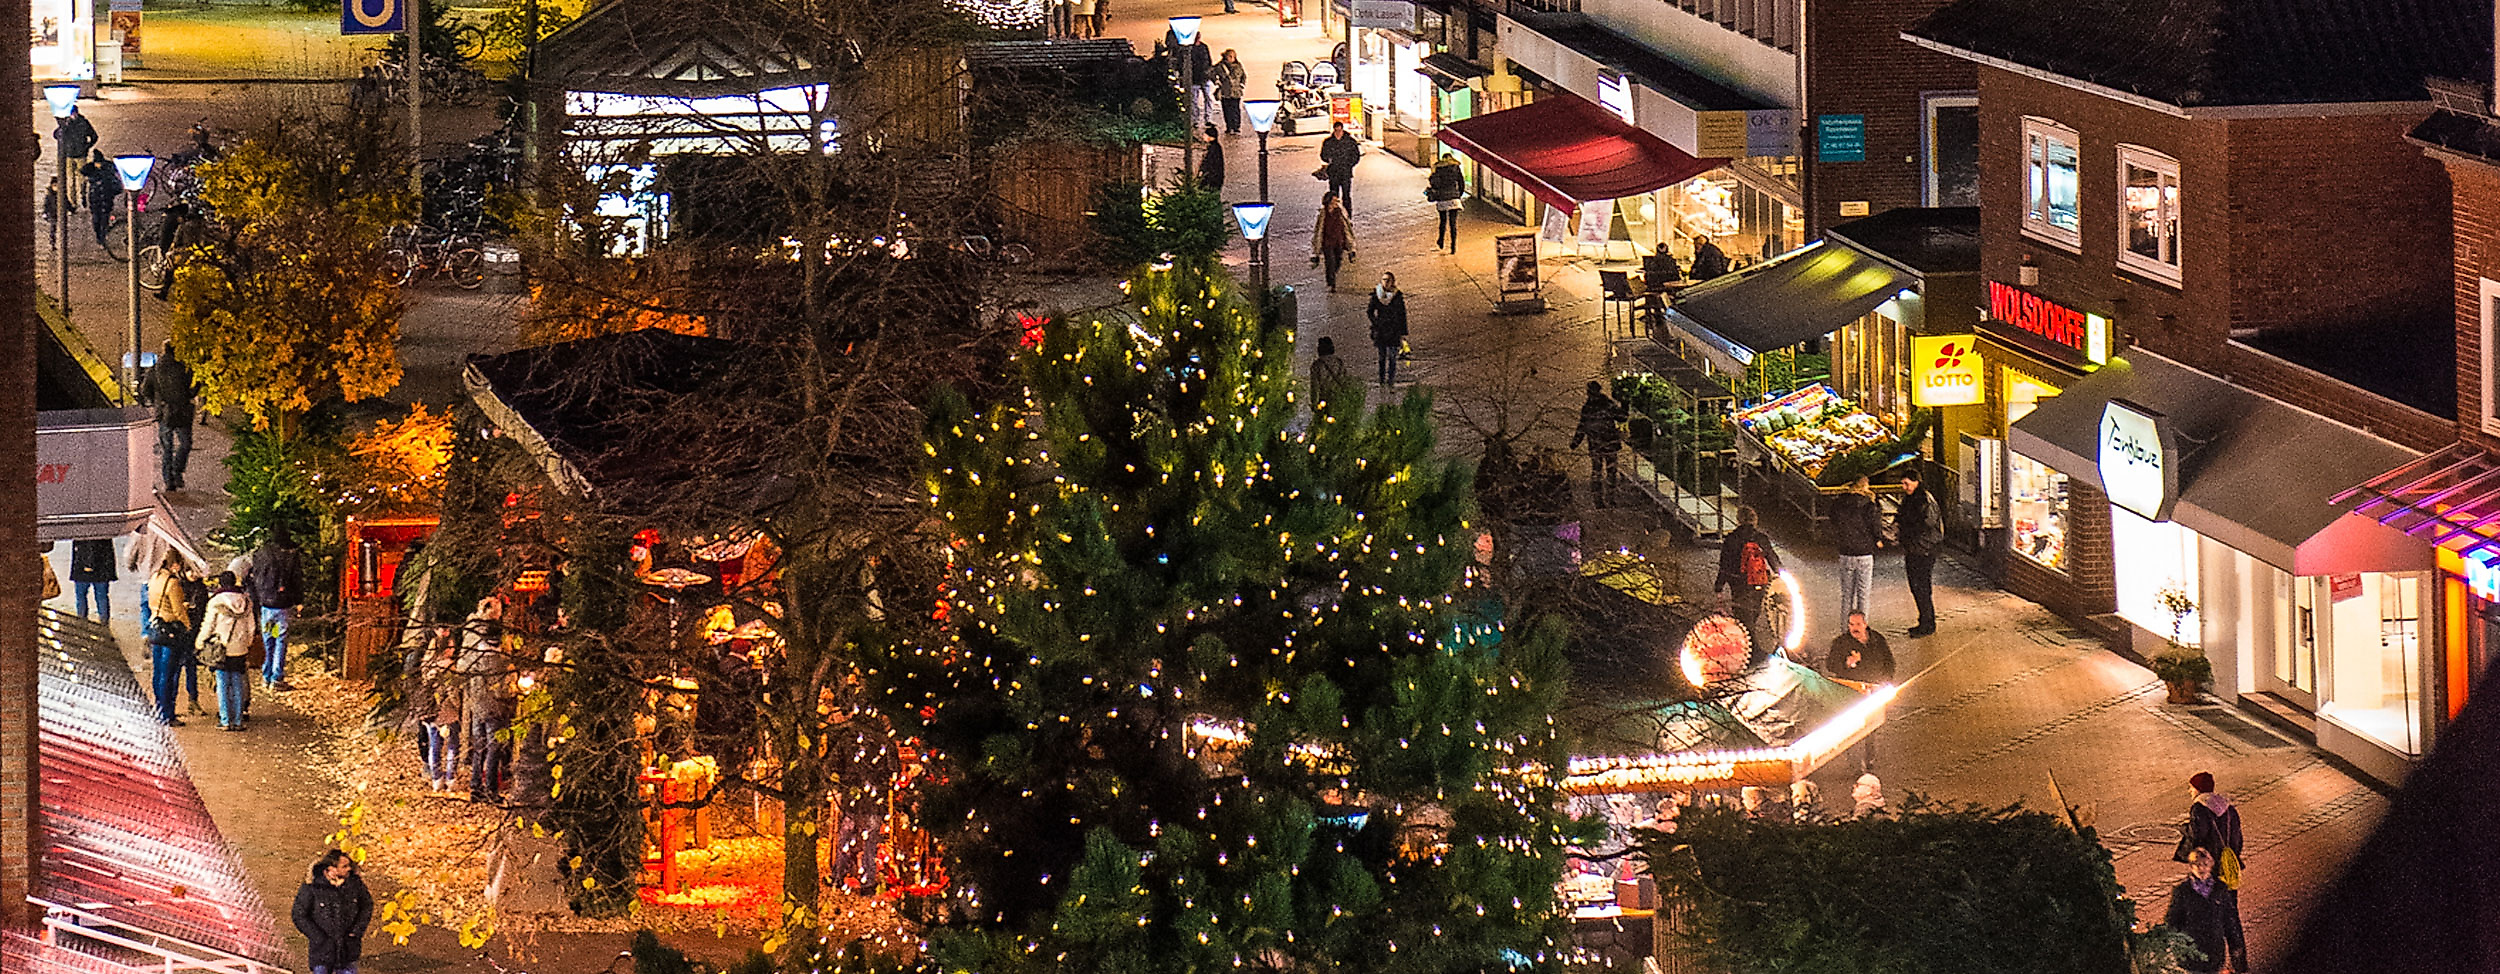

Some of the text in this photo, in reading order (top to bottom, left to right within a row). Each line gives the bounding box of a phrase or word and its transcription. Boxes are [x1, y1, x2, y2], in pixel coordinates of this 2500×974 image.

[1989, 280, 2084, 350] WOLSDORFF
[1925, 373, 1973, 388] LOTTO
[36, 463, 70, 484] AY
